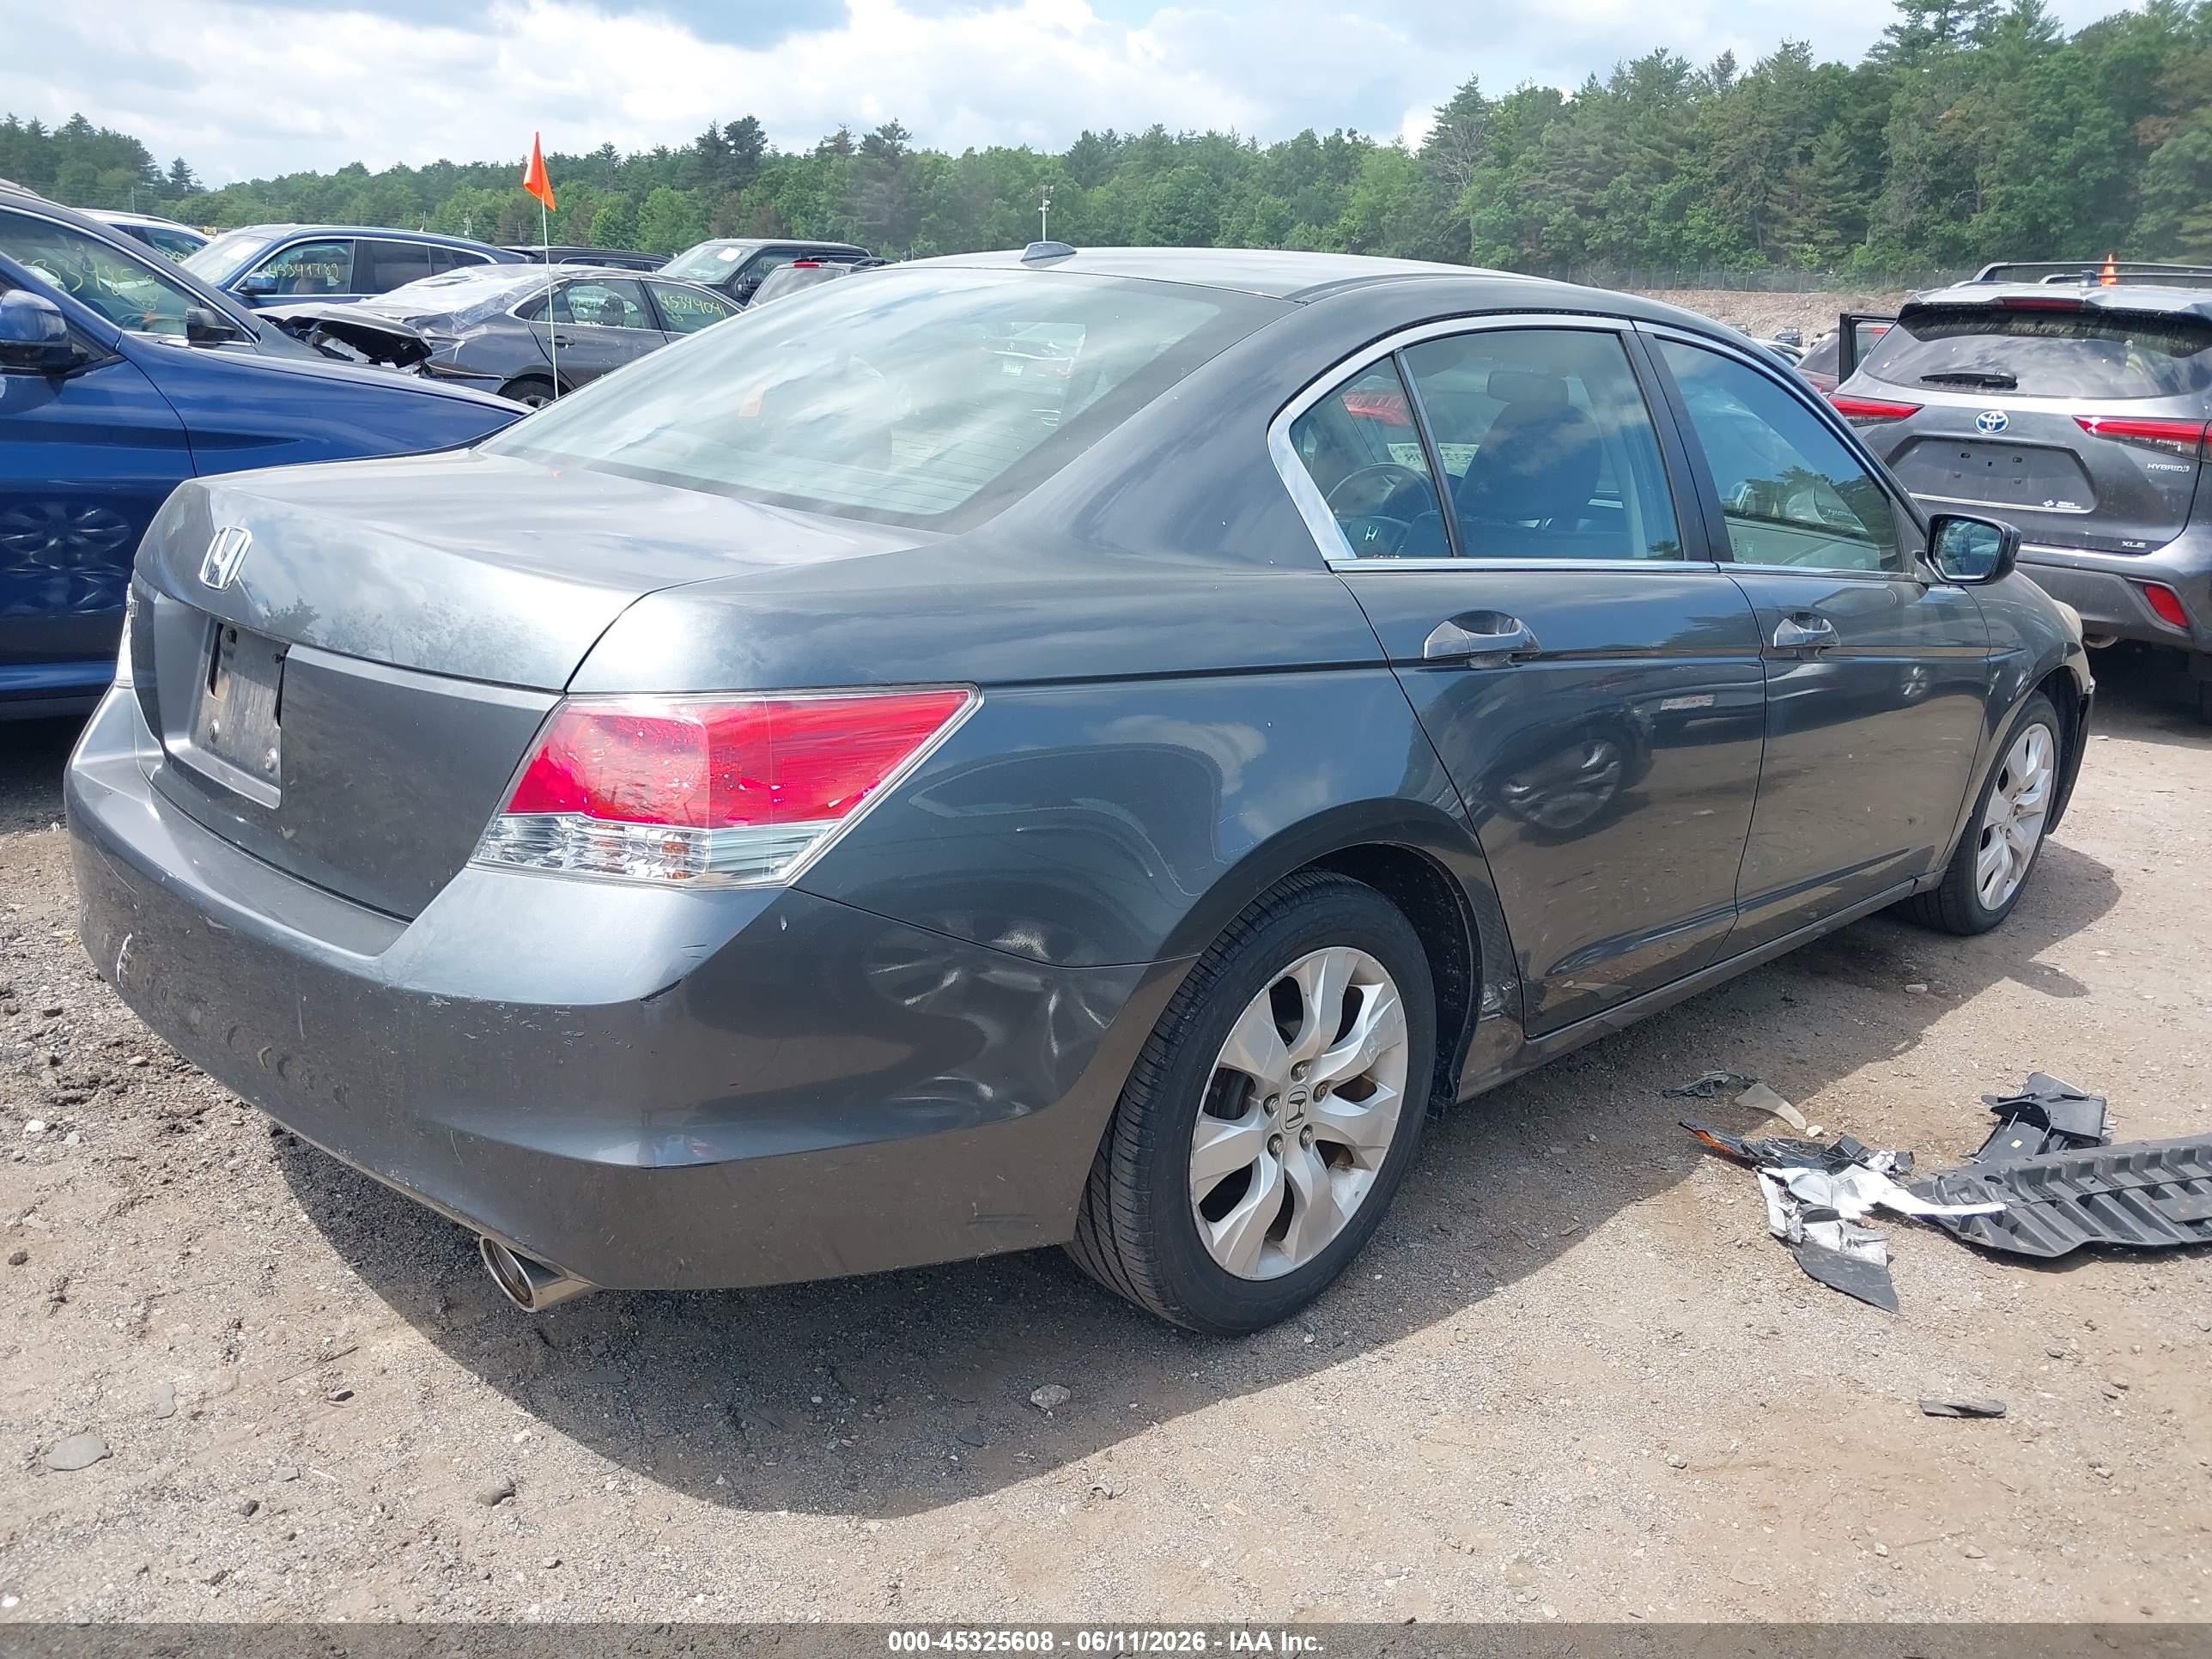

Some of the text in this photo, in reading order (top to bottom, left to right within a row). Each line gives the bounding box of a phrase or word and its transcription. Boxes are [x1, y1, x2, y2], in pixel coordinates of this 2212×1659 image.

[268, 263, 339, 278] 45341789
[658, 292, 727, 319] 45344041
[2147, 463, 2183, 472] HYBRID
